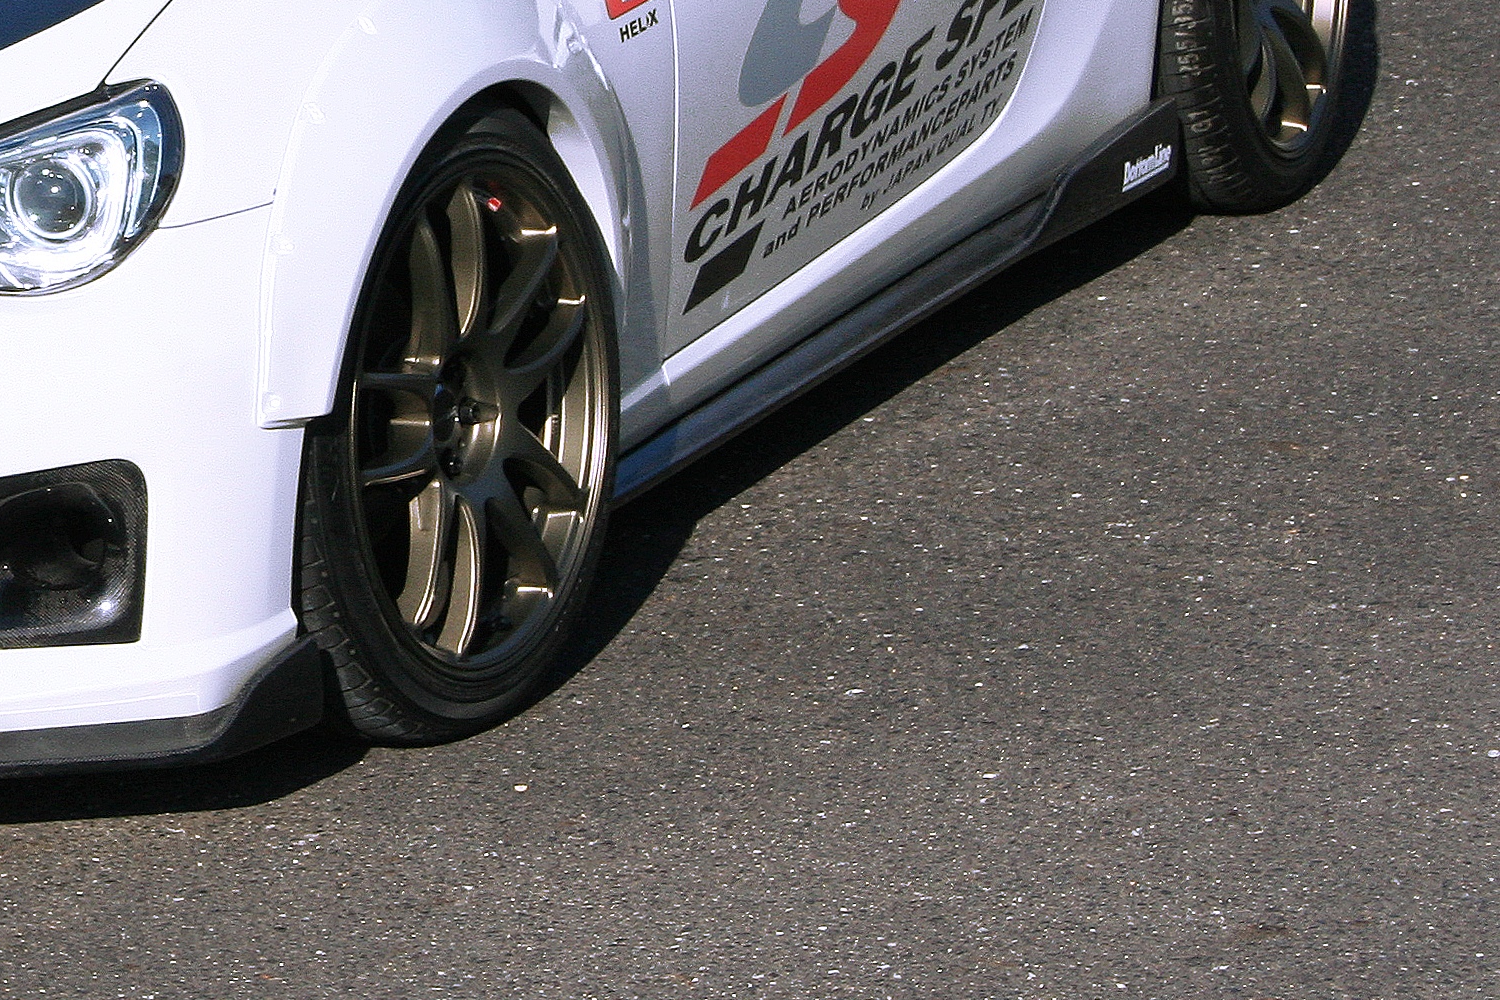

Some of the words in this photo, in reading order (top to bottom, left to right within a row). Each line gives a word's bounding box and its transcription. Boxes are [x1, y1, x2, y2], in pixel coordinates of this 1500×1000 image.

[619, 8, 658, 43] HELIX
[684, 25, 937, 263] CHARGE
[782, 75, 953, 221] AERODYNAMICS
[954, 7, 1034, 89] SYSTEM
[860, 189, 880, 211] by
[883, 143, 935, 195] JAPAN
[763, 216, 801, 258] and
